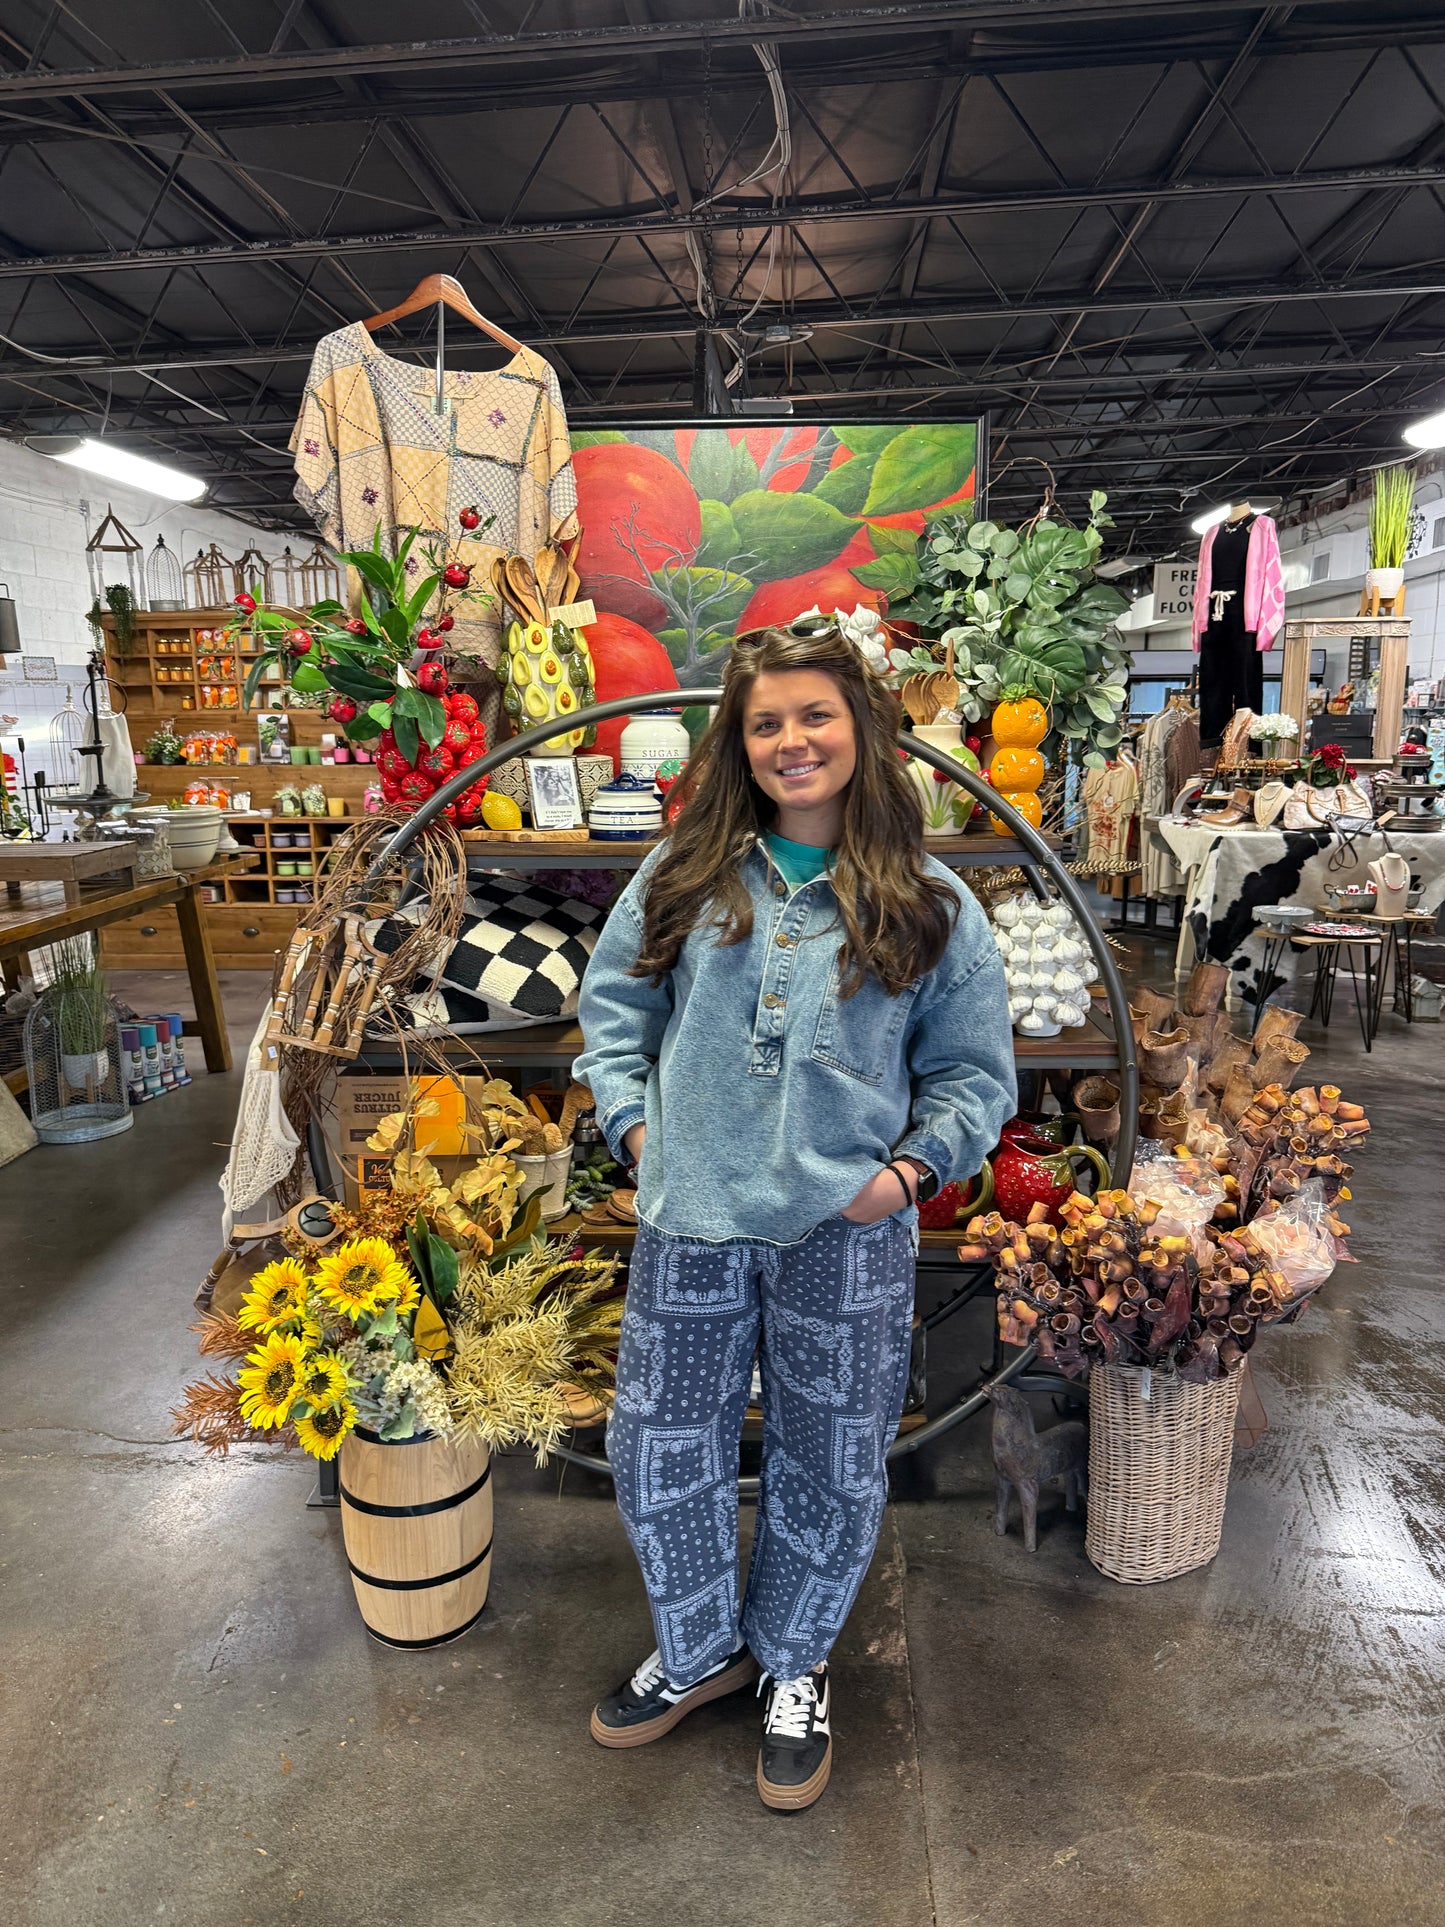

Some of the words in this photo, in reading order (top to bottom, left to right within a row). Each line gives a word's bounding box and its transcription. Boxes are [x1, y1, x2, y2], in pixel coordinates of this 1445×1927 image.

[641, 749, 680, 758] SUGAR
[610, 816, 634, 824] TEA
[352, 1091, 401, 1103] JUICER
[354, 1104, 401, 1114] CITRUS
